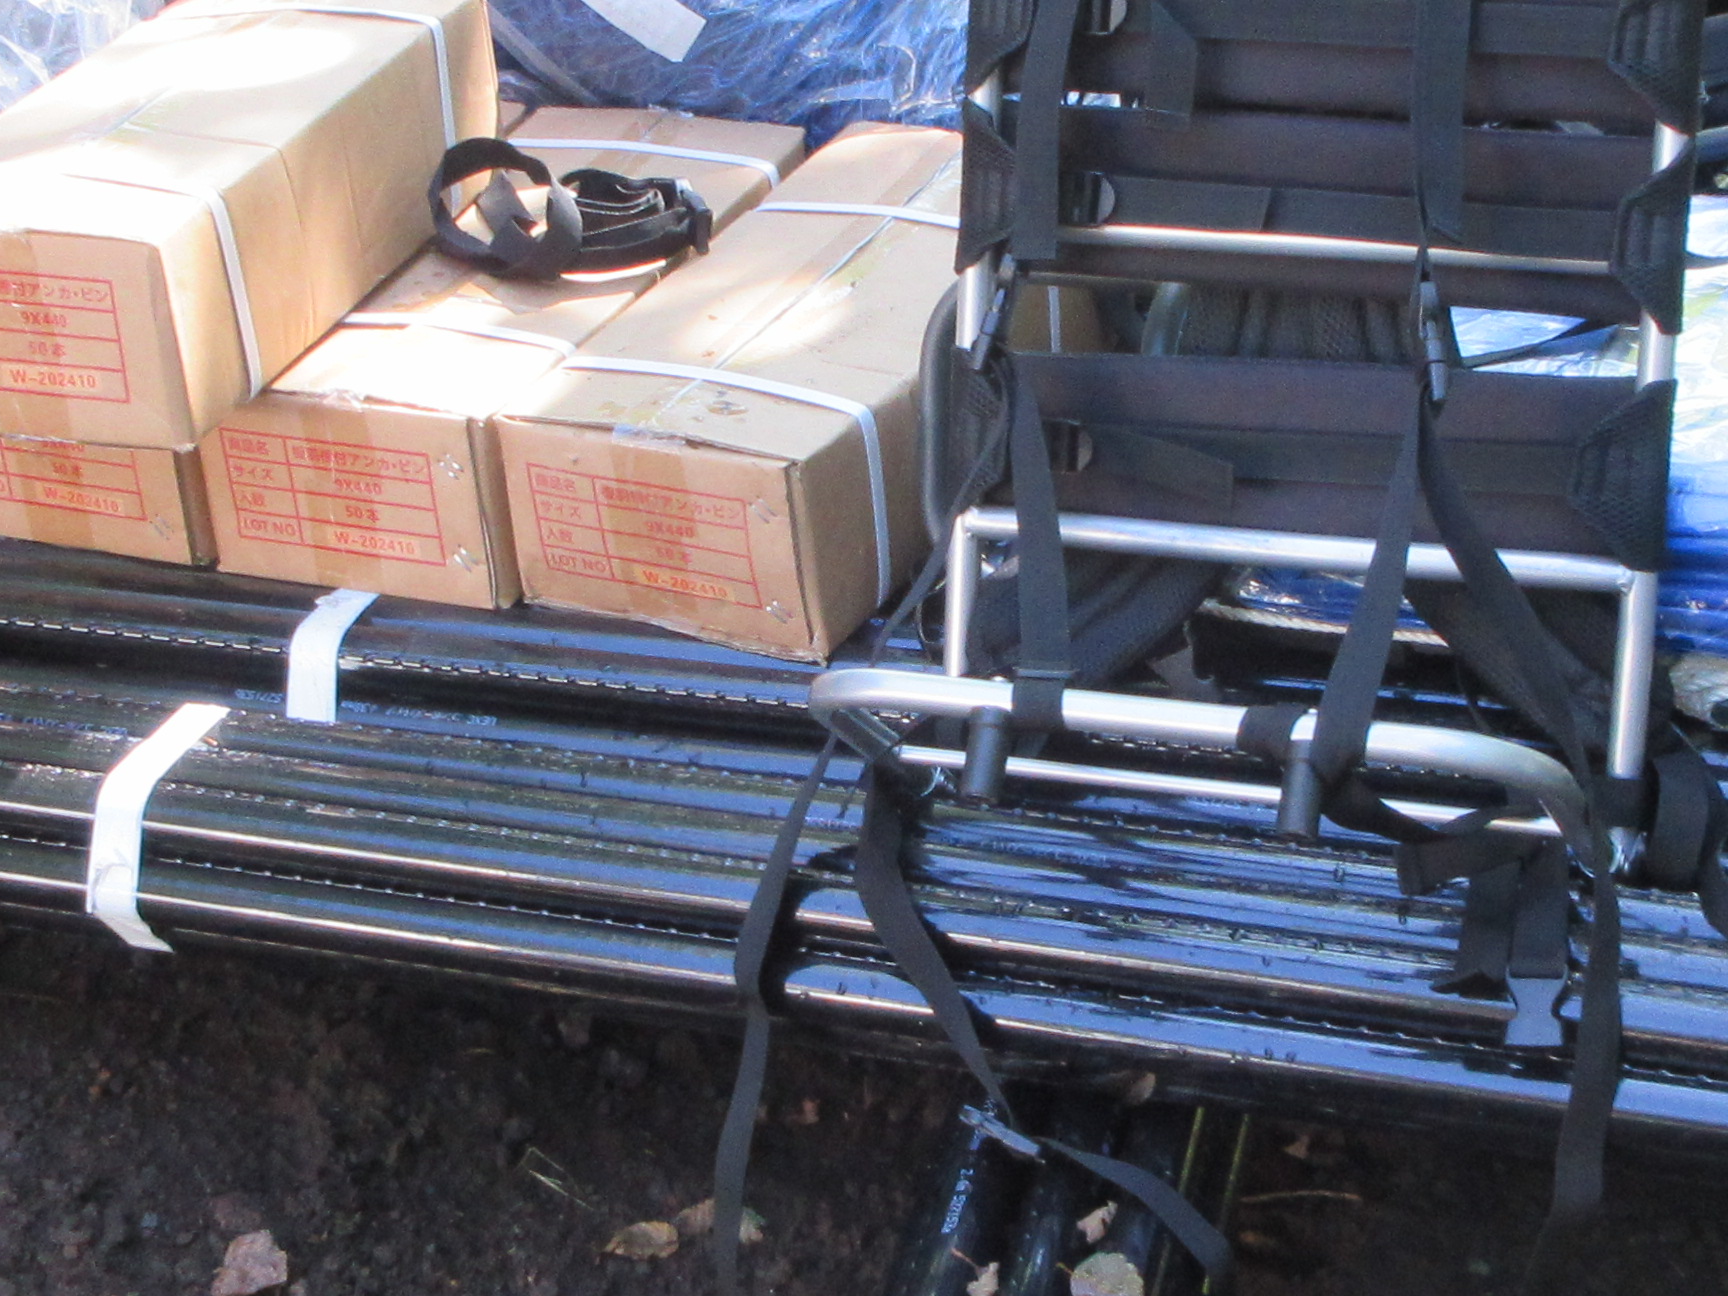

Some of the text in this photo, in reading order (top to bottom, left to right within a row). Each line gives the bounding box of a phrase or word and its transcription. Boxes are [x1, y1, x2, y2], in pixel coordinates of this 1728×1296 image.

[10, 369, 96, 389] W-202410
[242, 518, 296, 537] LOT NO
[334, 531, 415, 555] W-202410
[549, 554, 607, 574] LOT NO
[643, 569, 728, 598] W-202410
